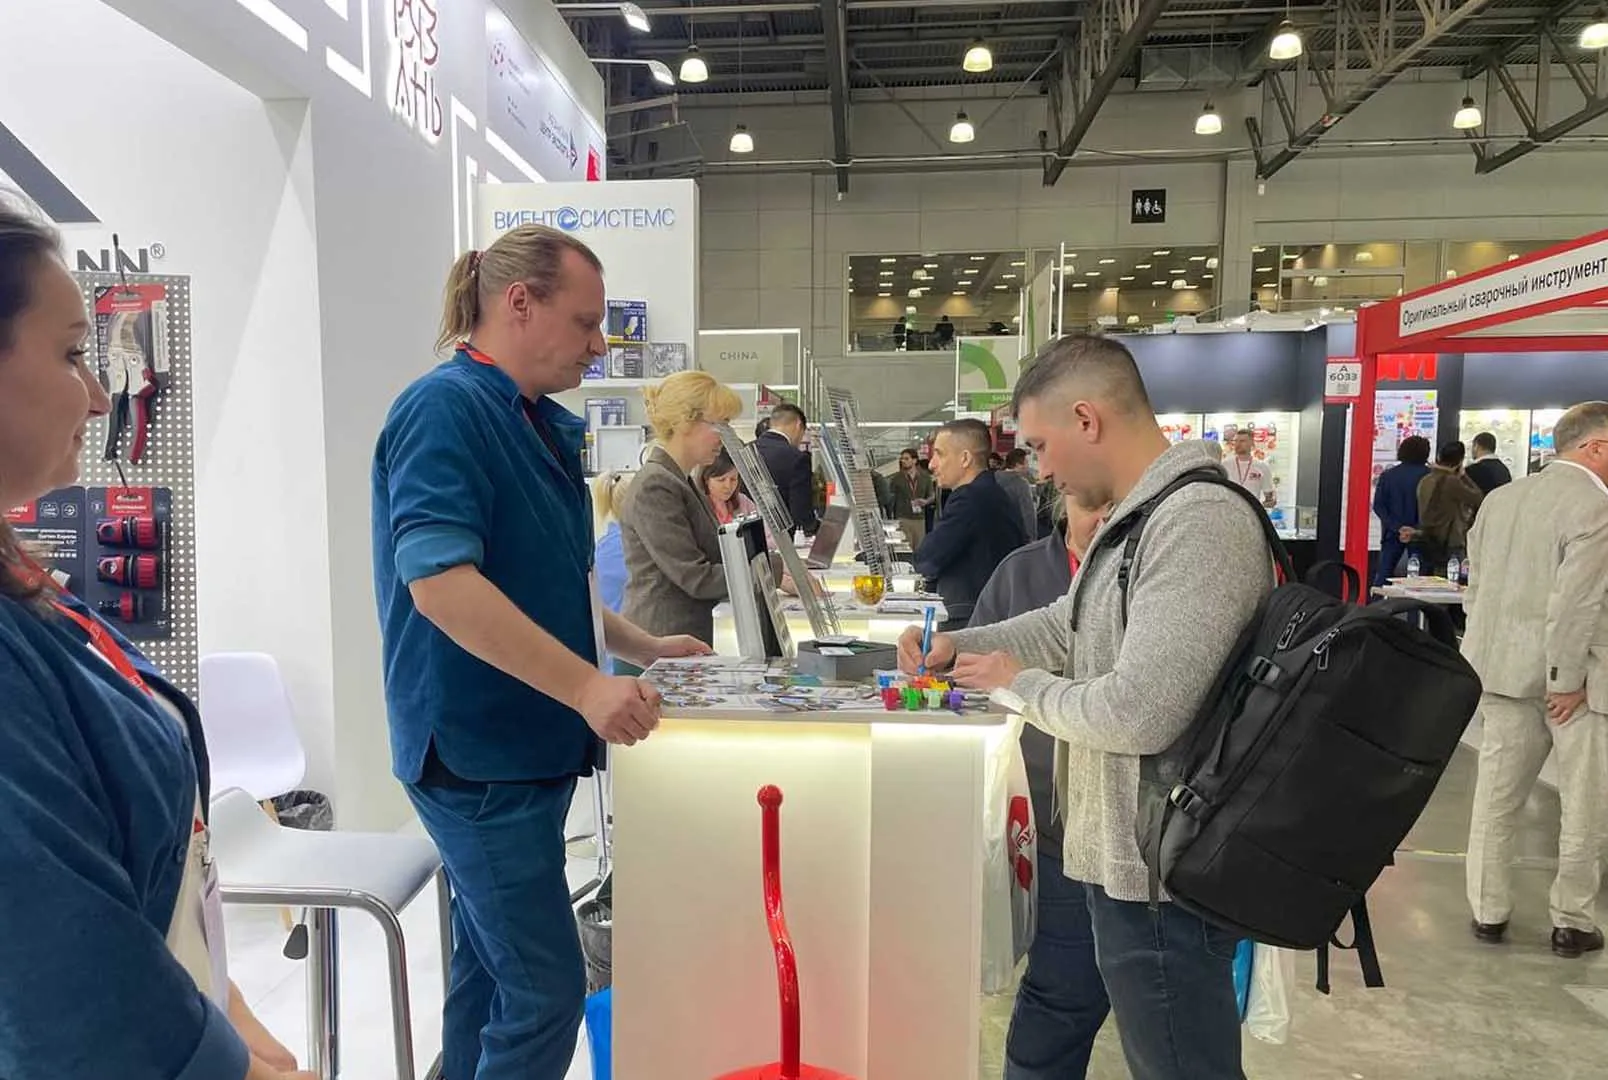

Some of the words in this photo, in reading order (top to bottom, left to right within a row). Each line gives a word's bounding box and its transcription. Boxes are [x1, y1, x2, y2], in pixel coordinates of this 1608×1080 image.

[1402, 293, 1467, 327] Оригинальный
[1468, 275, 1528, 310] сварочный
[1531, 257, 1608, 289] инструмент
[719, 351, 760, 361] CHINA
[1329, 373, 1358, 381] 6033
